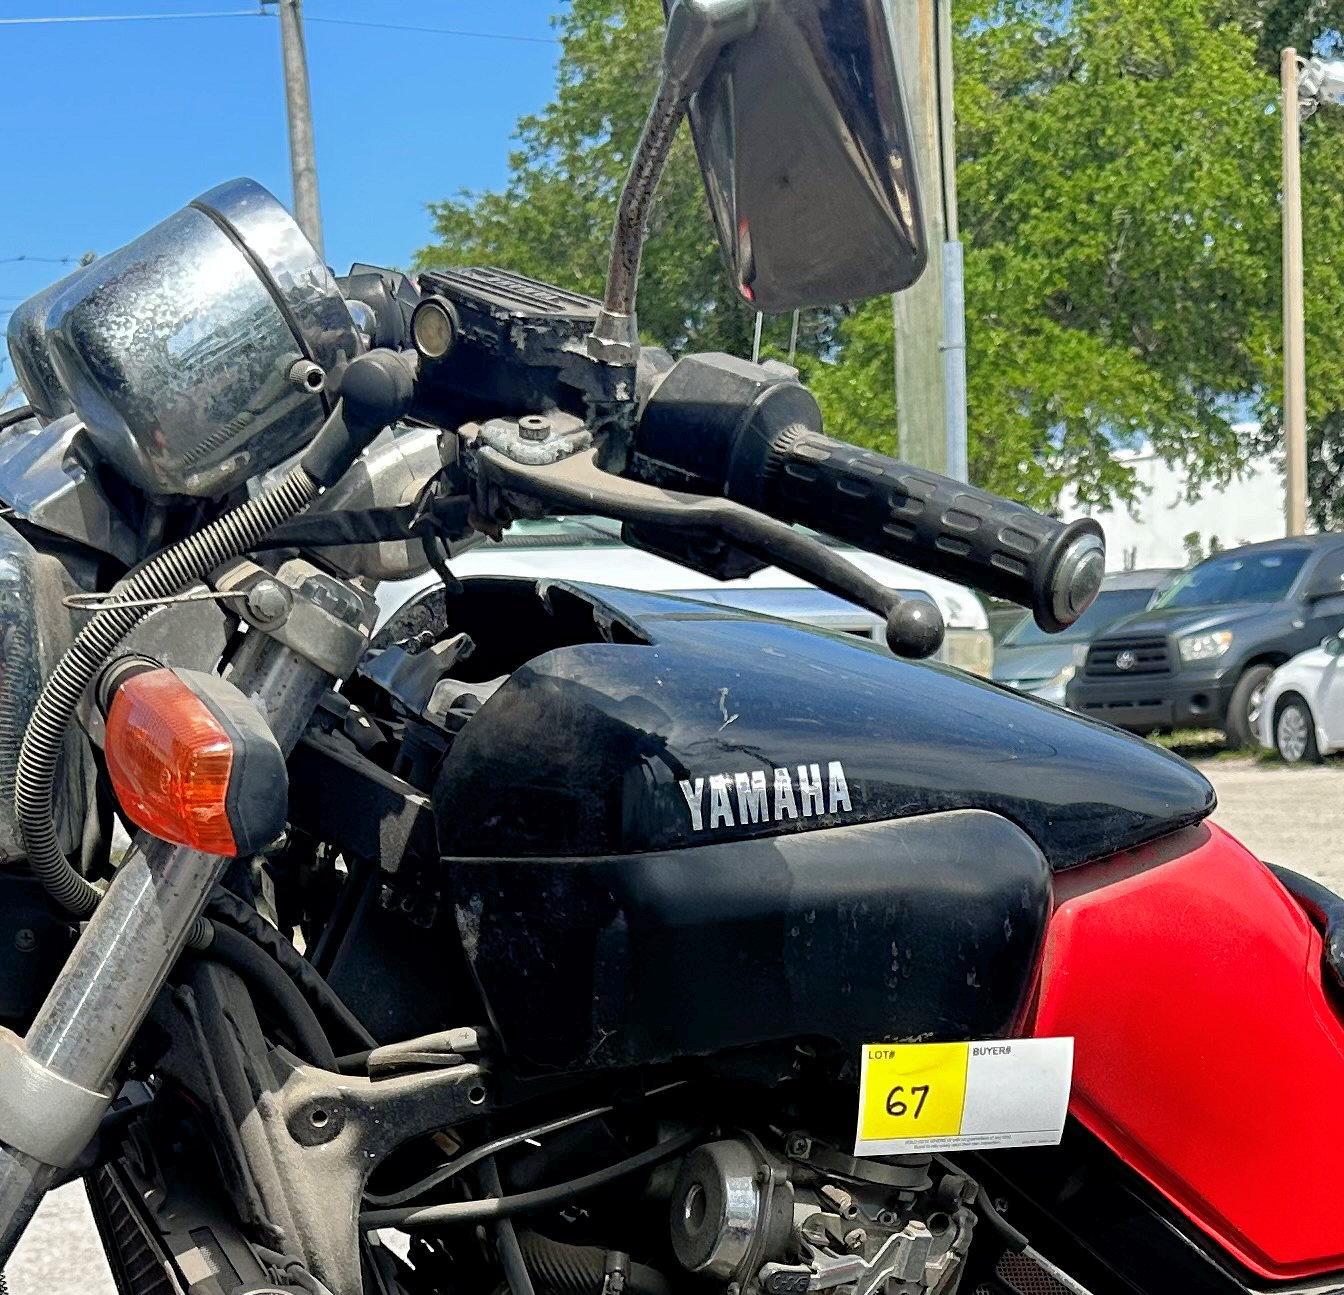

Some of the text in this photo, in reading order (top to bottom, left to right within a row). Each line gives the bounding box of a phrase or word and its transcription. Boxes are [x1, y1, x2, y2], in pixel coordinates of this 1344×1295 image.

[679, 760, 853, 831] YAMAHA
[868, 1050, 896, 1060] LOT#
[972, 1046, 1012, 1057] BUYER#
[885, 1085, 929, 1119] 67
